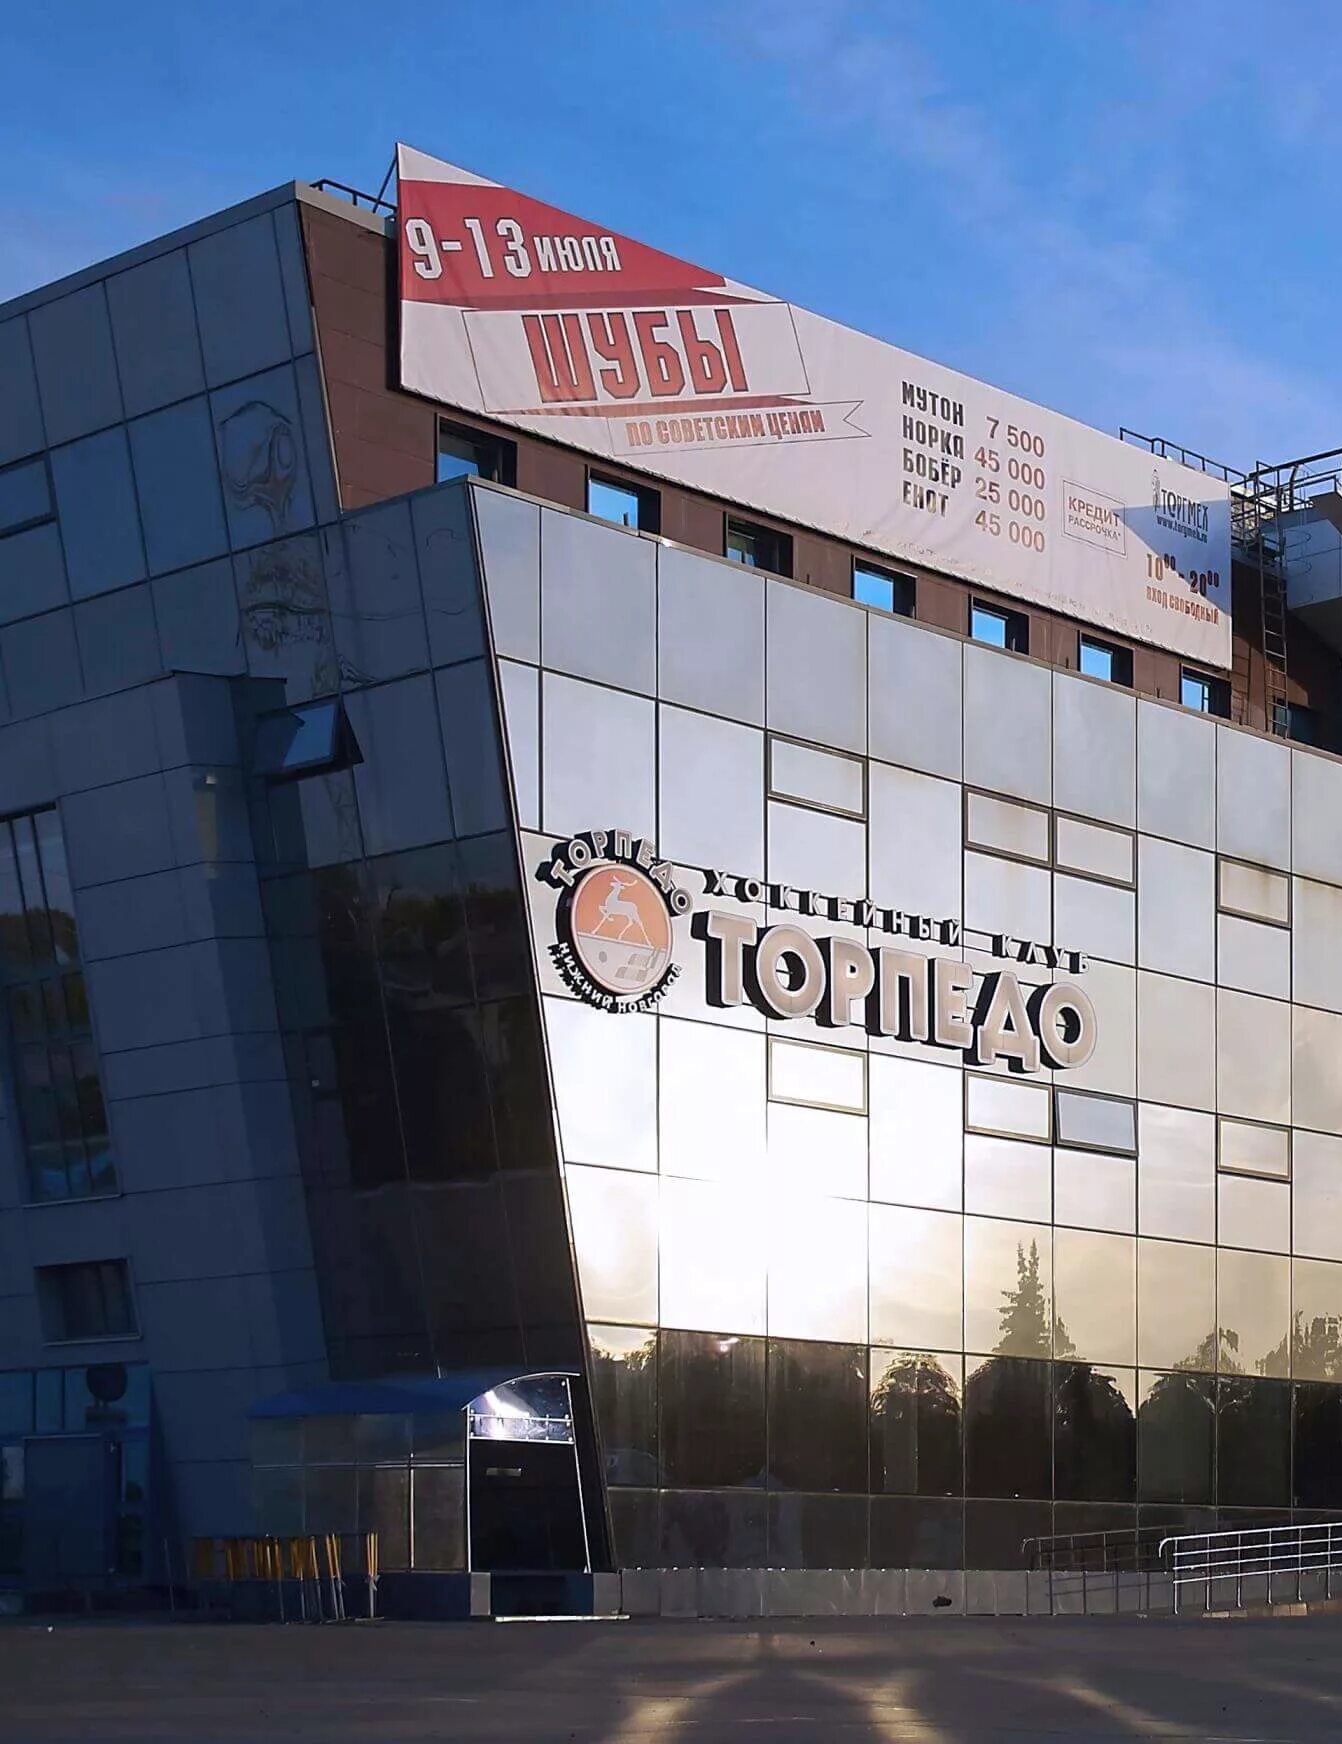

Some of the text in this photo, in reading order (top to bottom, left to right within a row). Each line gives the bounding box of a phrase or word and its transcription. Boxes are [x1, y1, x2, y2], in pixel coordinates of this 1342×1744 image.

[404, 217, 532, 280] 9-13
[521, 308, 749, 403] ШУБЫ
[901, 380, 964, 427] МУТОН
[626, 409, 826, 447] ПО СОВЕТСКИМ ЦЕНАМ
[902, 414, 964, 460] НОРКА
[985, 415, 1045, 458] 7 500
[902, 447, 962, 489] БОБЁР
[974, 445, 1046, 490] 45 000
[902, 480, 951, 518] ЕНОТ
[974, 476, 1046, 522] 25 000
[1067, 496, 1120, 527] КРЕДИТ
[1161, 488, 1209, 532] ТОРГМЕХ
[974, 509, 1046, 553] 45 000
[1146, 585, 1168, 609] ВХОД
[1169, 594, 1220, 626] СВОБОДНЫЙ
[548, 828, 694, 917] ТОРПЕДО
[707, 871, 1090, 974] ХОККЕЙНЫЙ КЛУБ
[555, 942, 683, 1014] НИЖНИЙ НОВГОРОД
[700, 909, 1098, 1072] ТОРПЕДО
